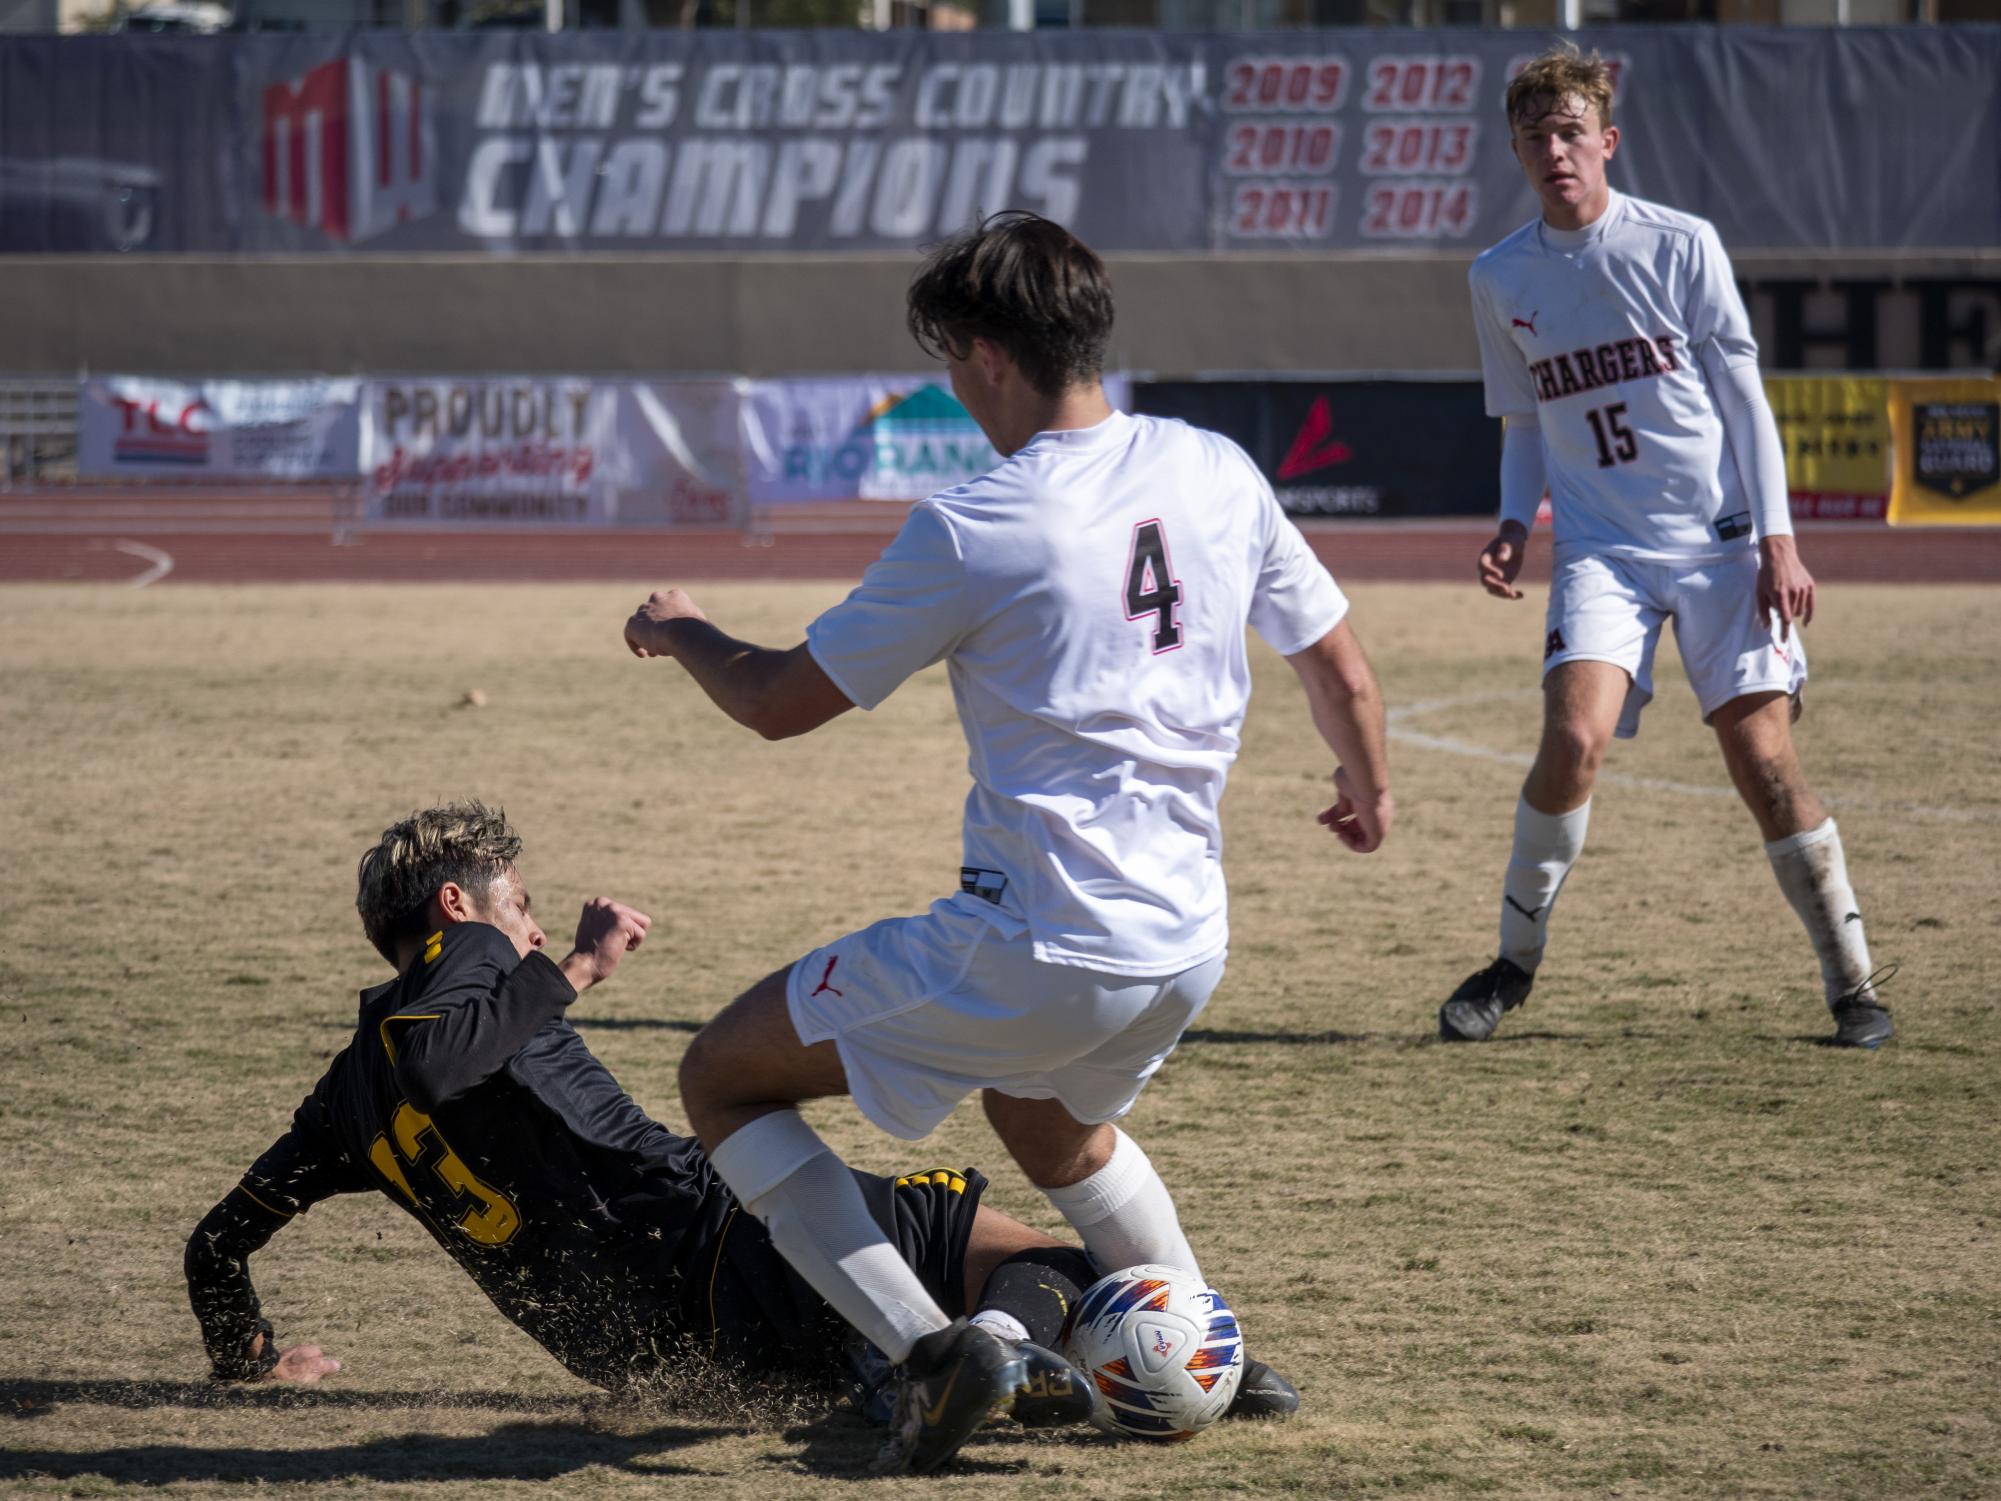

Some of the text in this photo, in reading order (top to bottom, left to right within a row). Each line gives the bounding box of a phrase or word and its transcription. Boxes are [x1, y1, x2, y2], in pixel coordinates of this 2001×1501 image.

[697, 63, 899, 129] CROSS
[914, 63, 1207, 129] COUNTRY
[1226, 60, 1346, 109] 2009
[1366, 60, 1479, 109] 2012
[1227, 122, 1339, 172] 2010
[1363, 122, 1477, 172] 2013
[458, 137, 1087, 238] CHAMPIONS
[1235, 186, 1334, 235] 2011
[1364, 186, 1474, 235] 2014
[384, 387, 591, 439] PROUDLY
[1585, 402, 1638, 469] 15
[1121, 517, 1185, 656] 4
